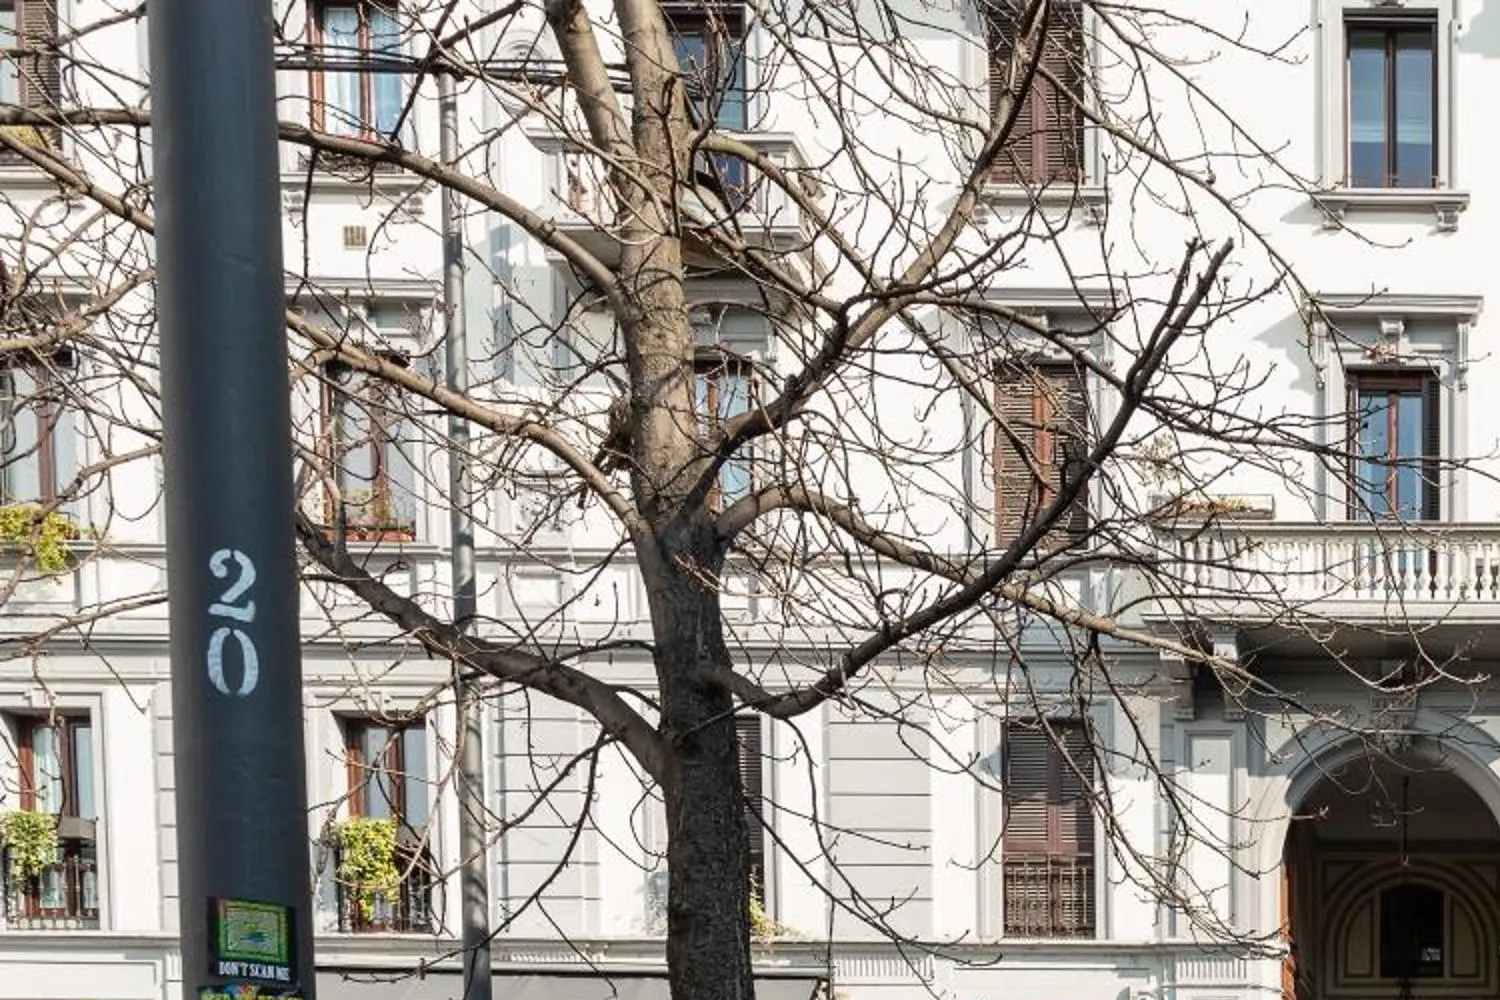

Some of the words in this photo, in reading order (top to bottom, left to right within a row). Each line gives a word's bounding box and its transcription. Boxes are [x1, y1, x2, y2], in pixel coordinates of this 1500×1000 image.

[207, 548, 259, 695] 20
[218, 961, 249, 977] DON'T
[249, 963, 275, 979] SCAN
[275, 966, 290, 981] ME
